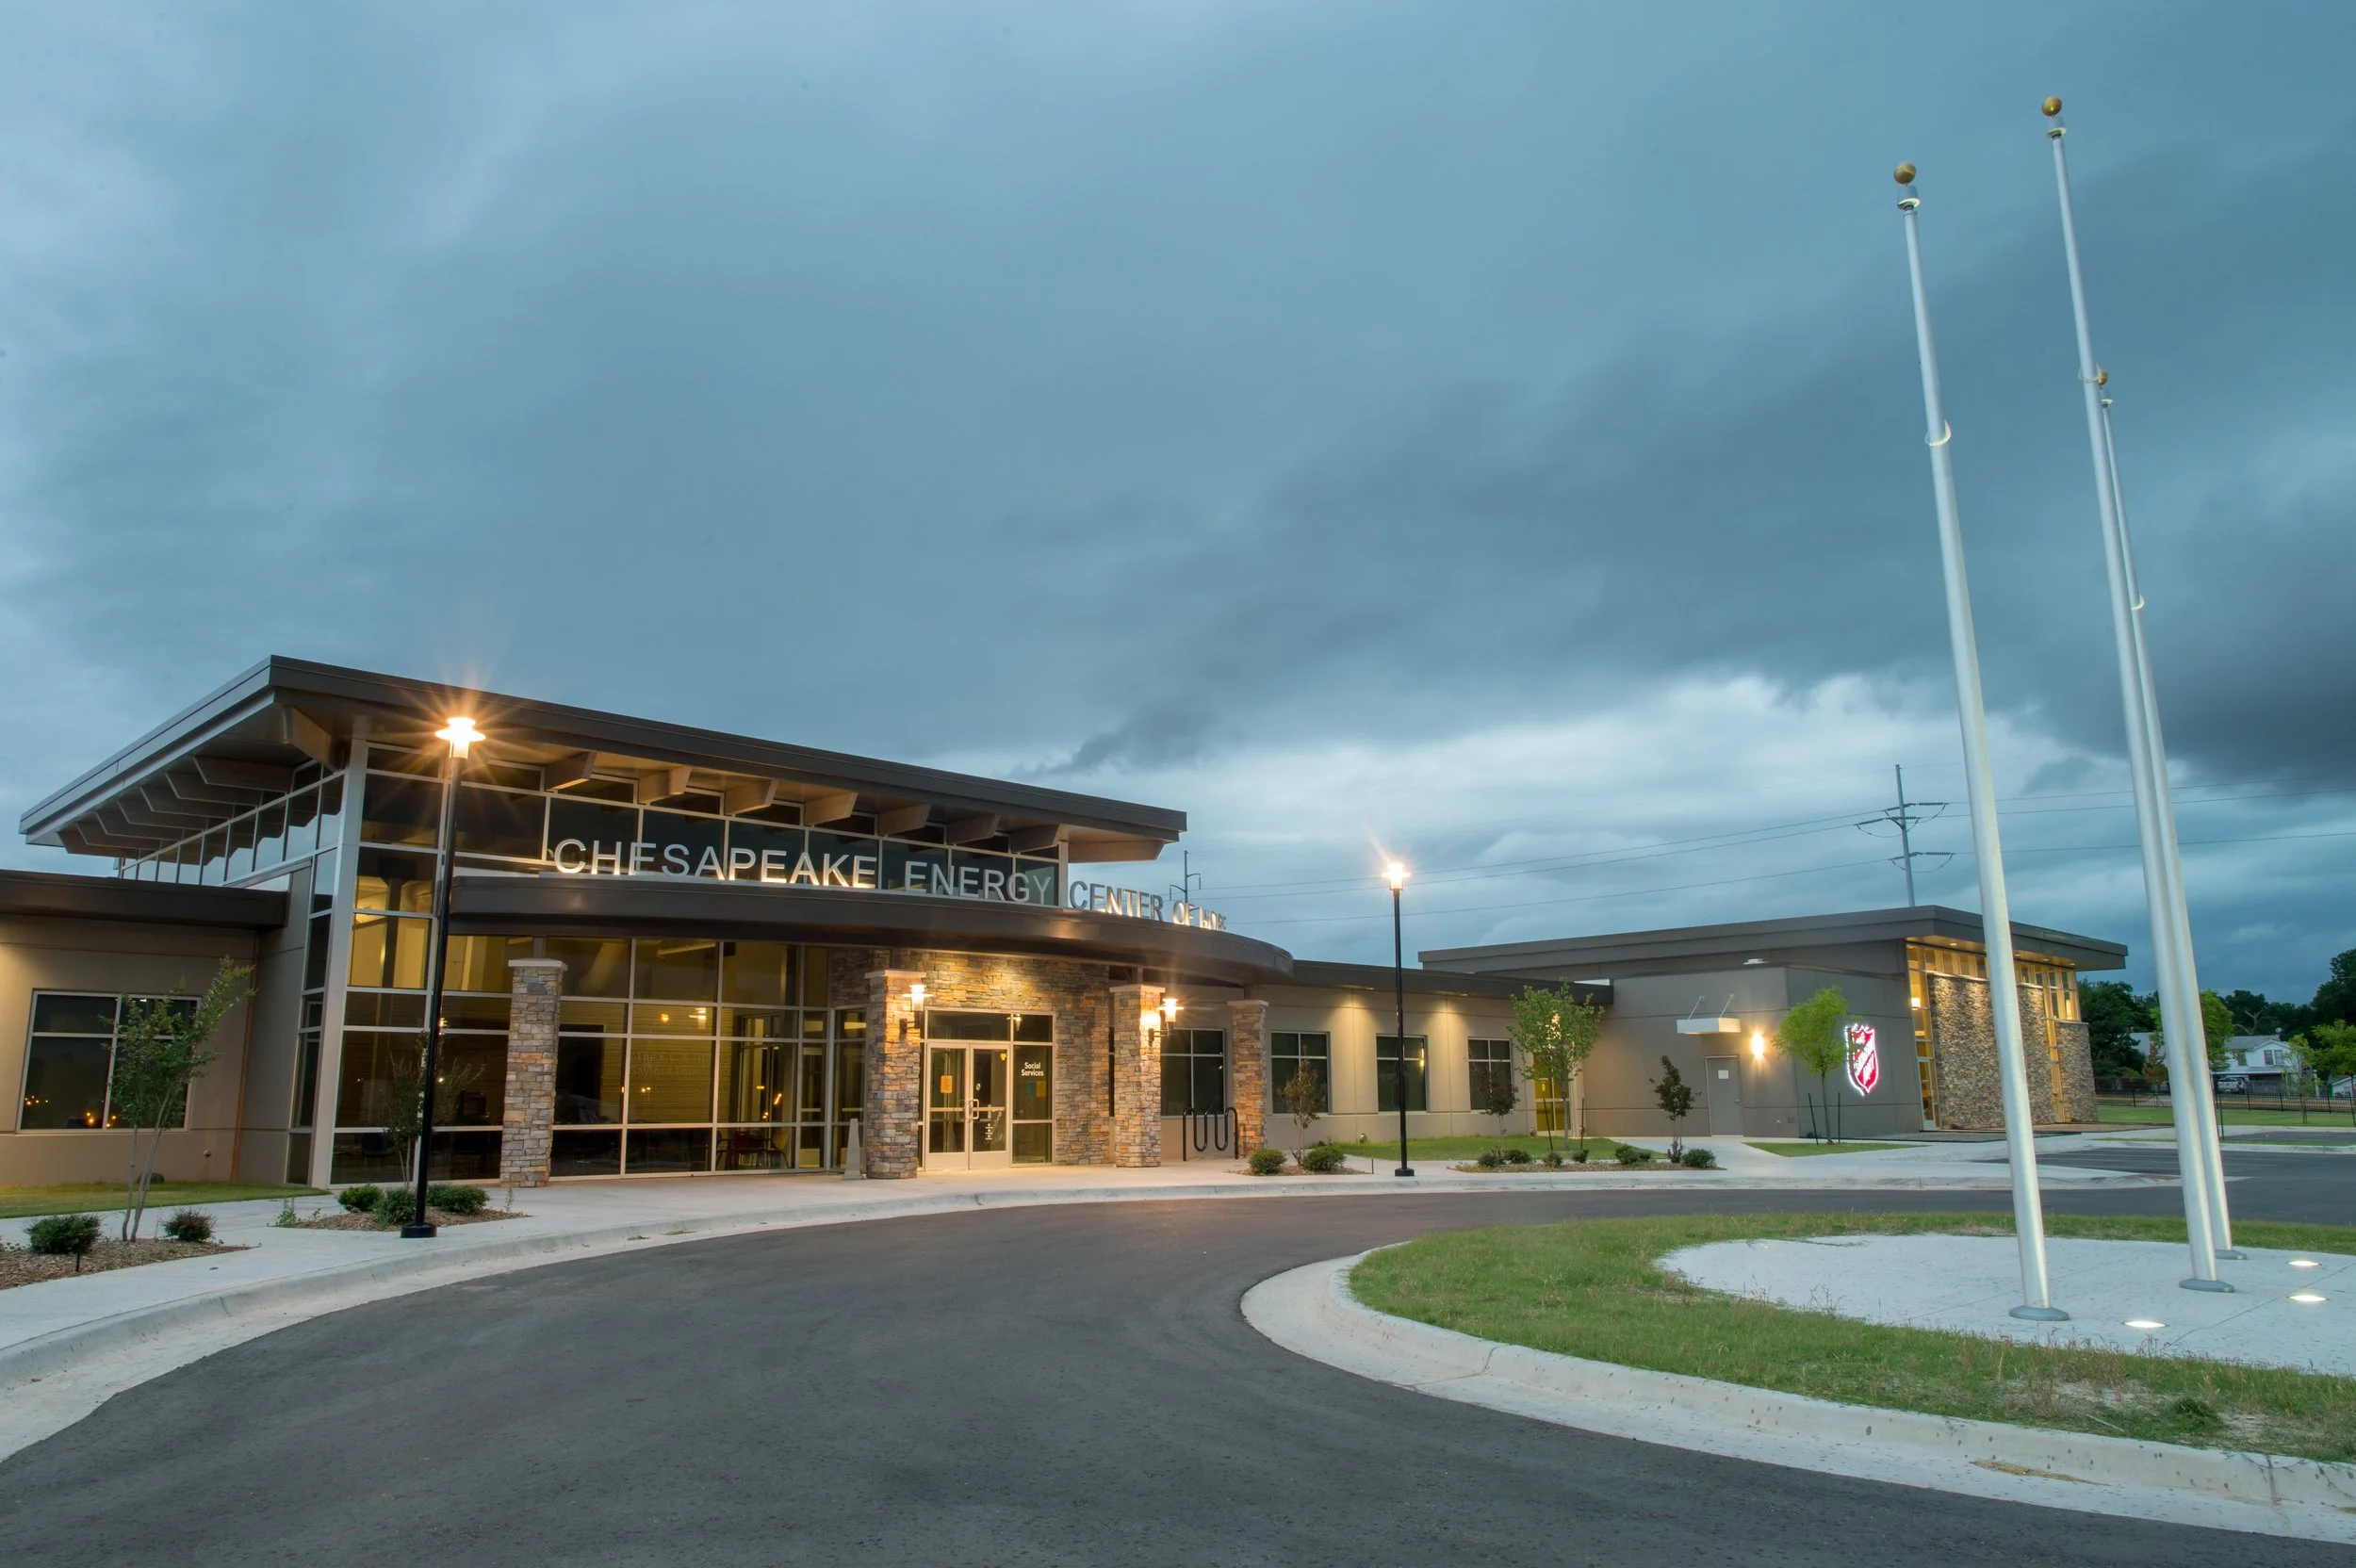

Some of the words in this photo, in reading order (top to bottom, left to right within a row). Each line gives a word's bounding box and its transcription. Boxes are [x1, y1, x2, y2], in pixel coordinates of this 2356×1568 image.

[554, 839, 877, 889] CHESAPEAKE
[904, 859, 1053, 906] ENERGY
[1070, 880, 1164, 922] CENTER
[1172, 900, 1194, 926] OF
[1024, 1061, 1041, 1070] Social
[1021, 1069, 1044, 1077] Services
